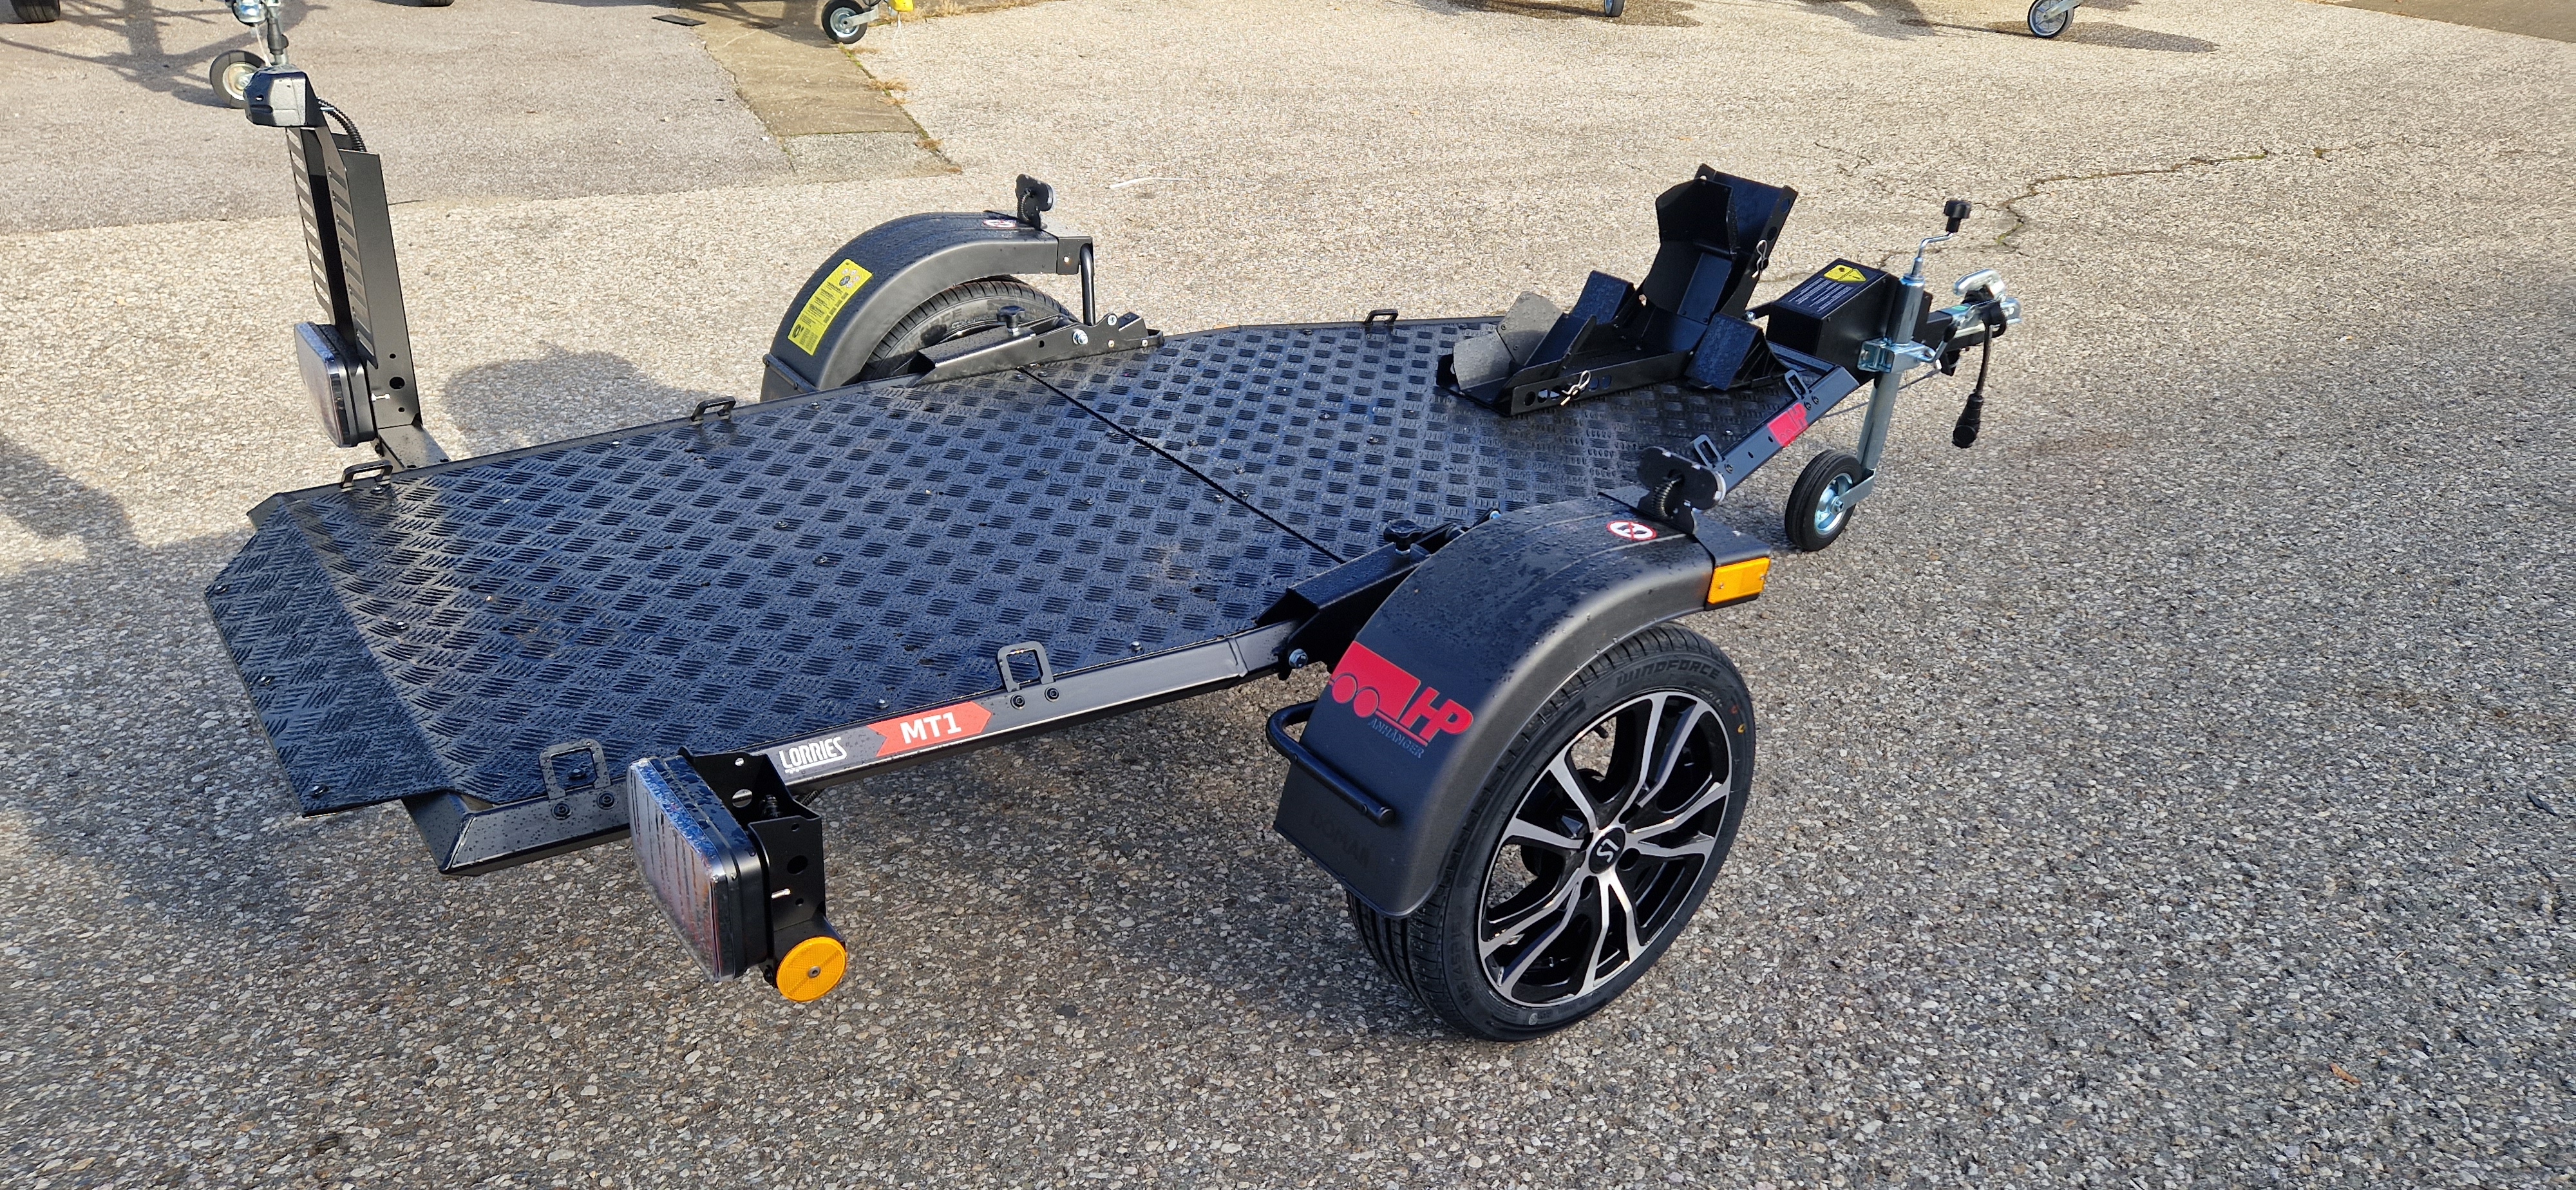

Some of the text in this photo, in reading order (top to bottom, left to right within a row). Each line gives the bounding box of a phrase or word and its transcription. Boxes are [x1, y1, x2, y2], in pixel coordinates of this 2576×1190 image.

[1616, 659, 1721, 688] WINDFORCE
[1399, 686, 1474, 742] HP
[779, 711, 961, 770] LORRIES MT1
[1368, 718, 1425, 759] ANHÄNGER
